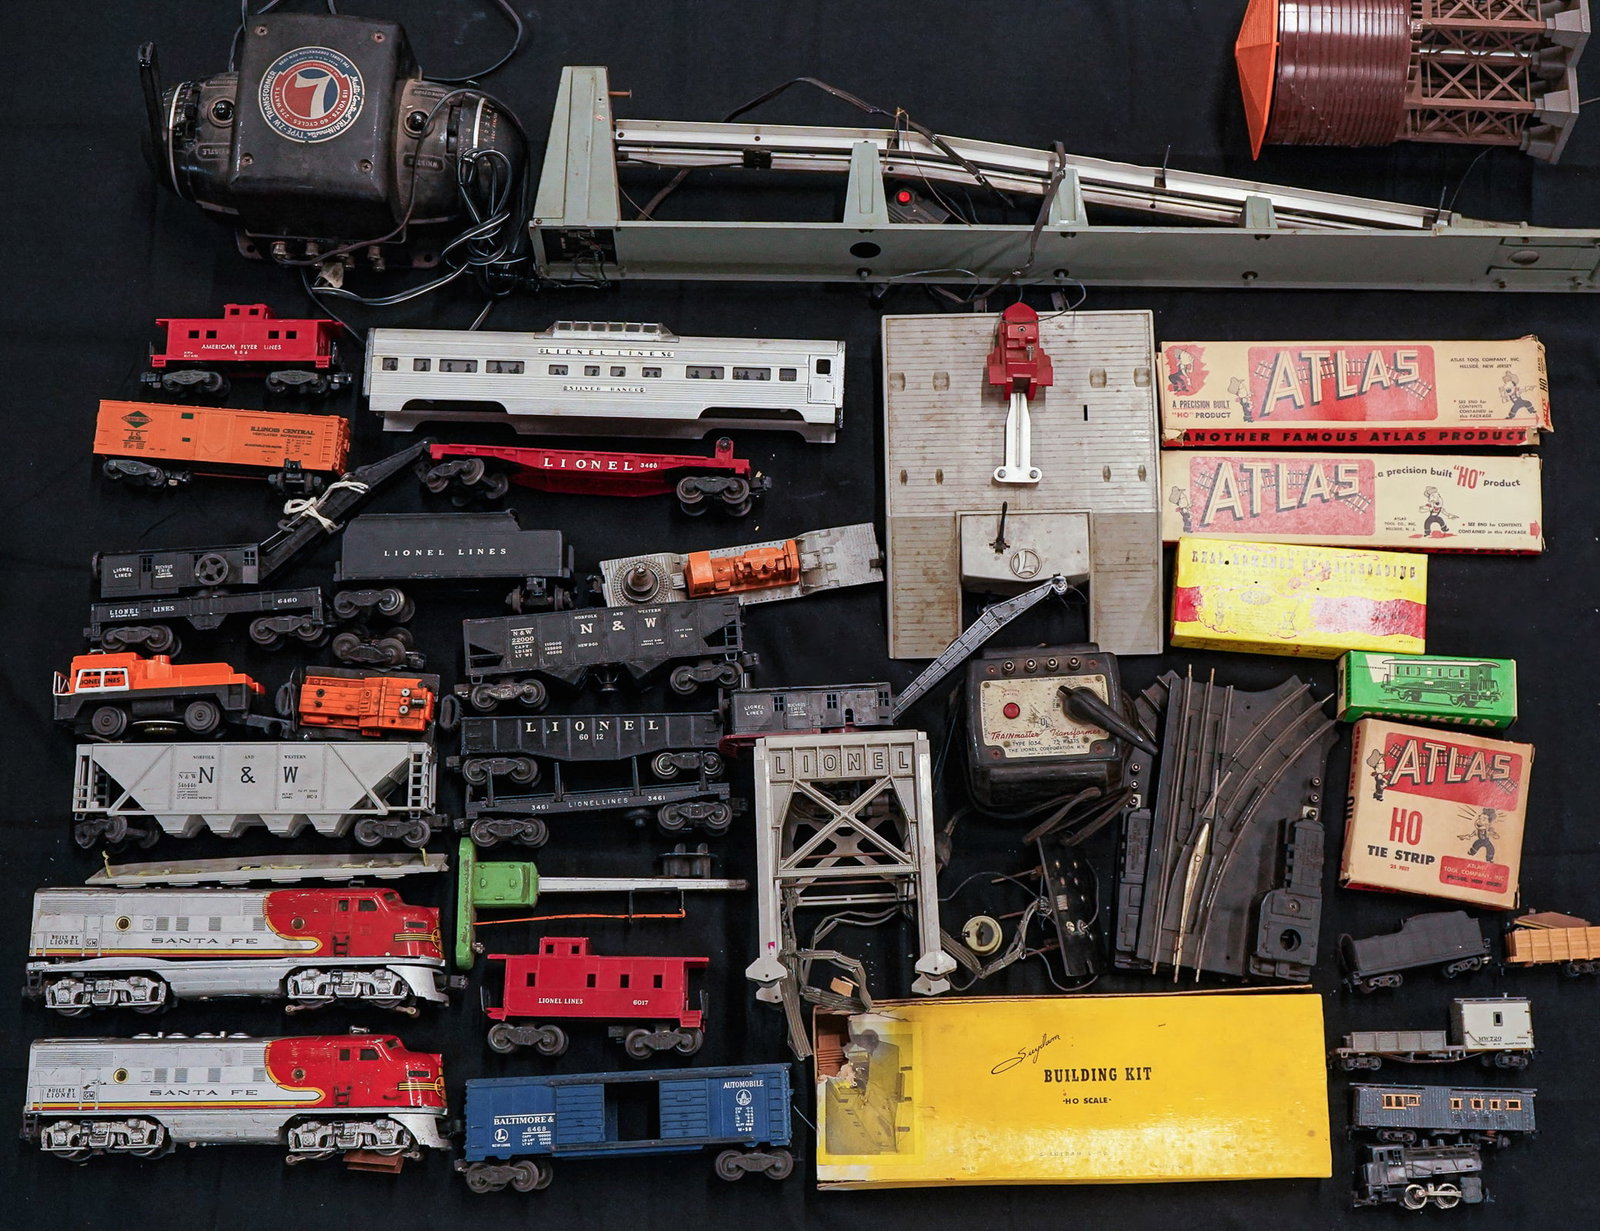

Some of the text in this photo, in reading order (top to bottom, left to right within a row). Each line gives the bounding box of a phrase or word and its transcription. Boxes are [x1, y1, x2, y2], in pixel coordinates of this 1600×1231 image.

[262, 70, 276, 120] TRANSFORMER
[332, 100, 347, 118] VOLTS
[294, 118, 318, 127] CYCLES
[408, 158, 438, 168] WHISTE
[1259, 350, 1420, 418] ATLAS
[1180, 400, 1210, 408] PRECISION
[1213, 401, 1230, 409] BUILT
[1183, 431, 1526, 442] ANOTHER FAMOUS ATLAS PRODUCT
[544, 458, 634, 471] LIONEL
[1387, 466, 1427, 479] precision
[1430, 467, 1452, 478] built
[1484, 479, 1521, 487] product
[1200, 462, 1360, 528] ATLAS
[110, 608, 140, 616] LIONEL
[580, 617, 657, 634] N & W
[526, 720, 659, 733] LIONEL
[991, 730, 1040, 740] TRAINmaster
[776, 751, 909, 774] LIONEL
[1388, 739, 1512, 786] ATLAS
[198, 766, 298, 784] N & W
[1389, 807, 1423, 846] HO
[1367, 845, 1436, 865] TIE STRIP
[1044, 1067, 1152, 1082] BUILDING KIT
[723, 1080, 764, 1089] AUTOMOBILE
[494, 1116, 546, 1125] BALTIMORE
